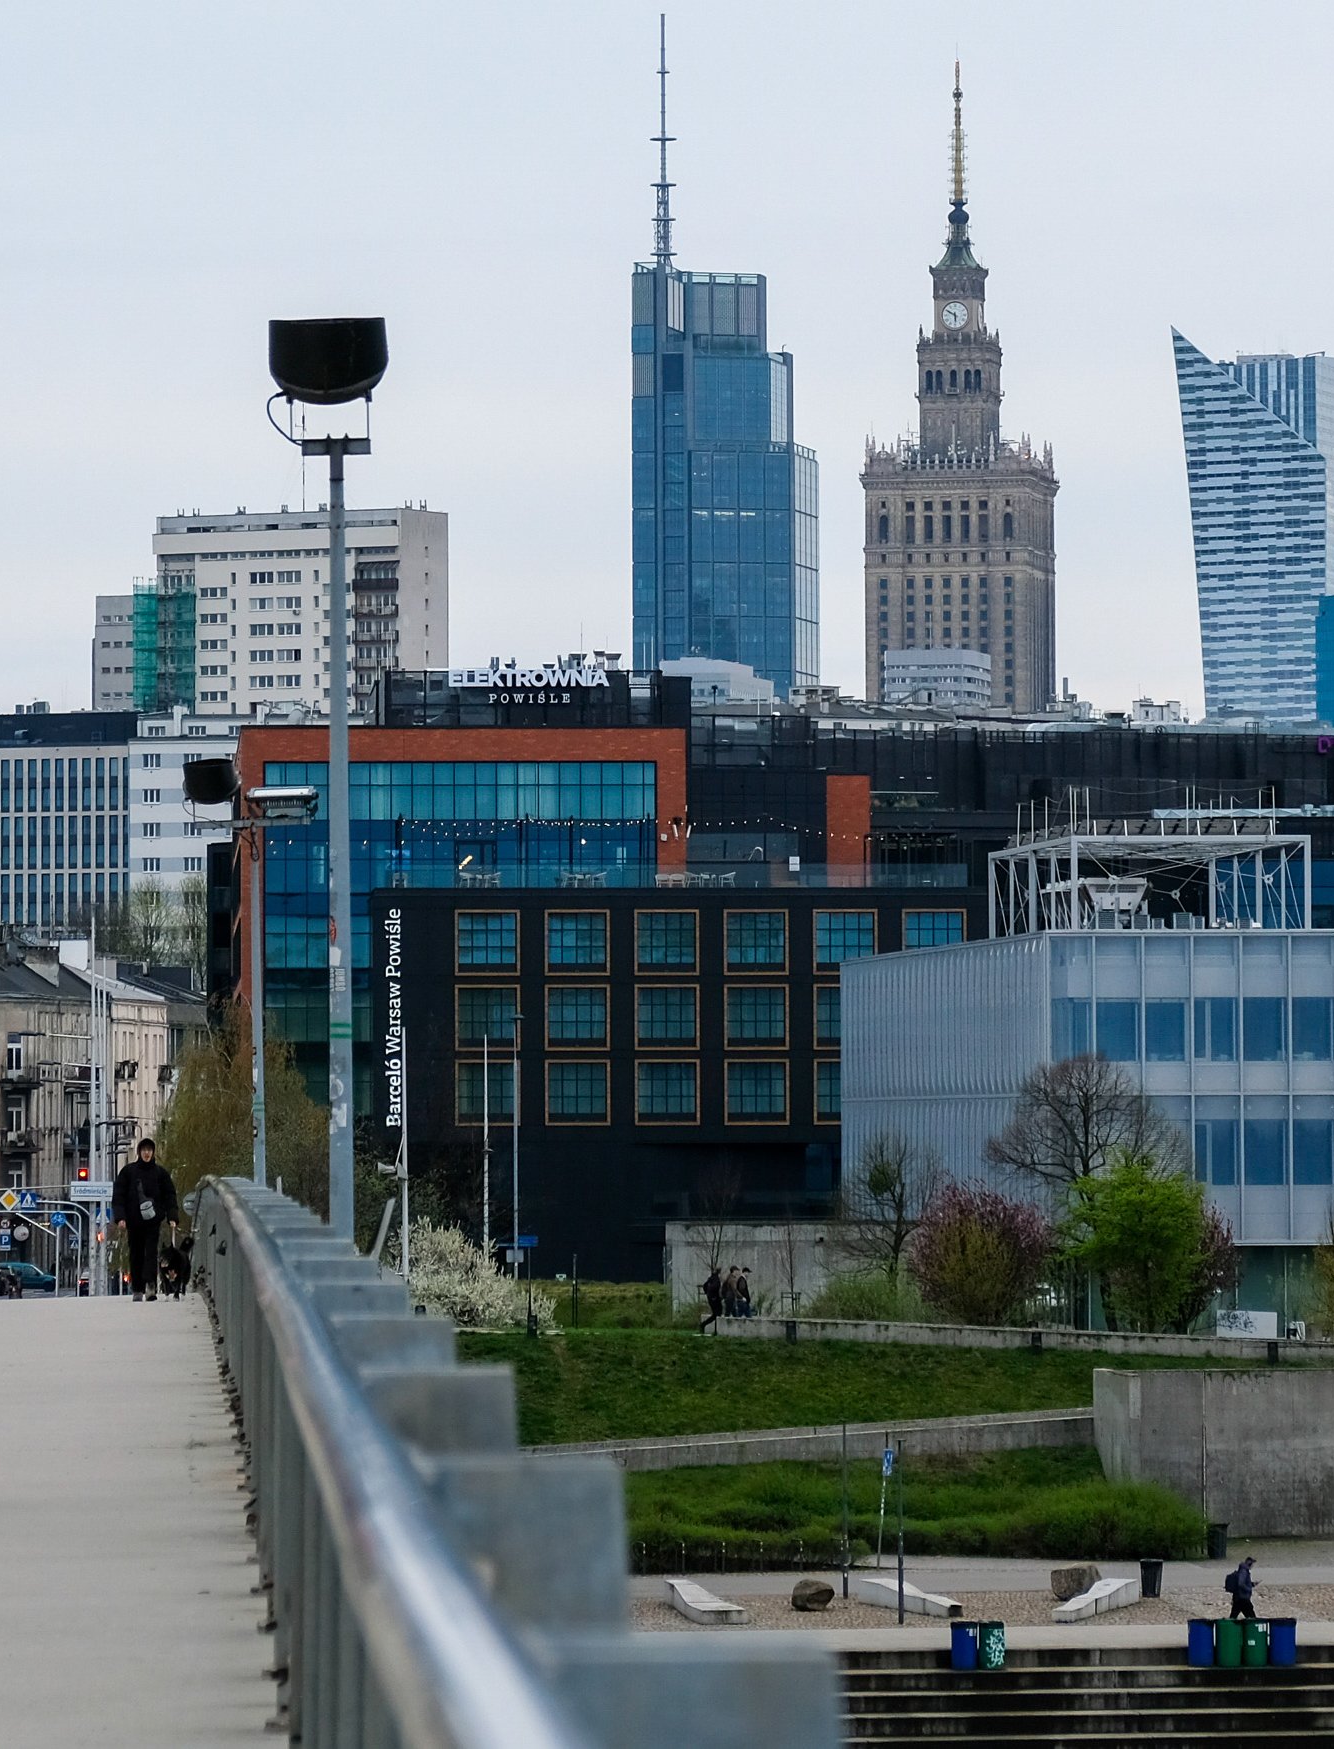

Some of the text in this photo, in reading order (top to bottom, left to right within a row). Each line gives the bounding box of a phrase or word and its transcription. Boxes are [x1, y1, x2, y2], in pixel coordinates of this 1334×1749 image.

[448, 669, 610, 688] ELEKTROWNIA
[488, 690, 571, 704] POWIŚLE
[384, 907, 402, 1128] Barceló Warsaw Powiśle
